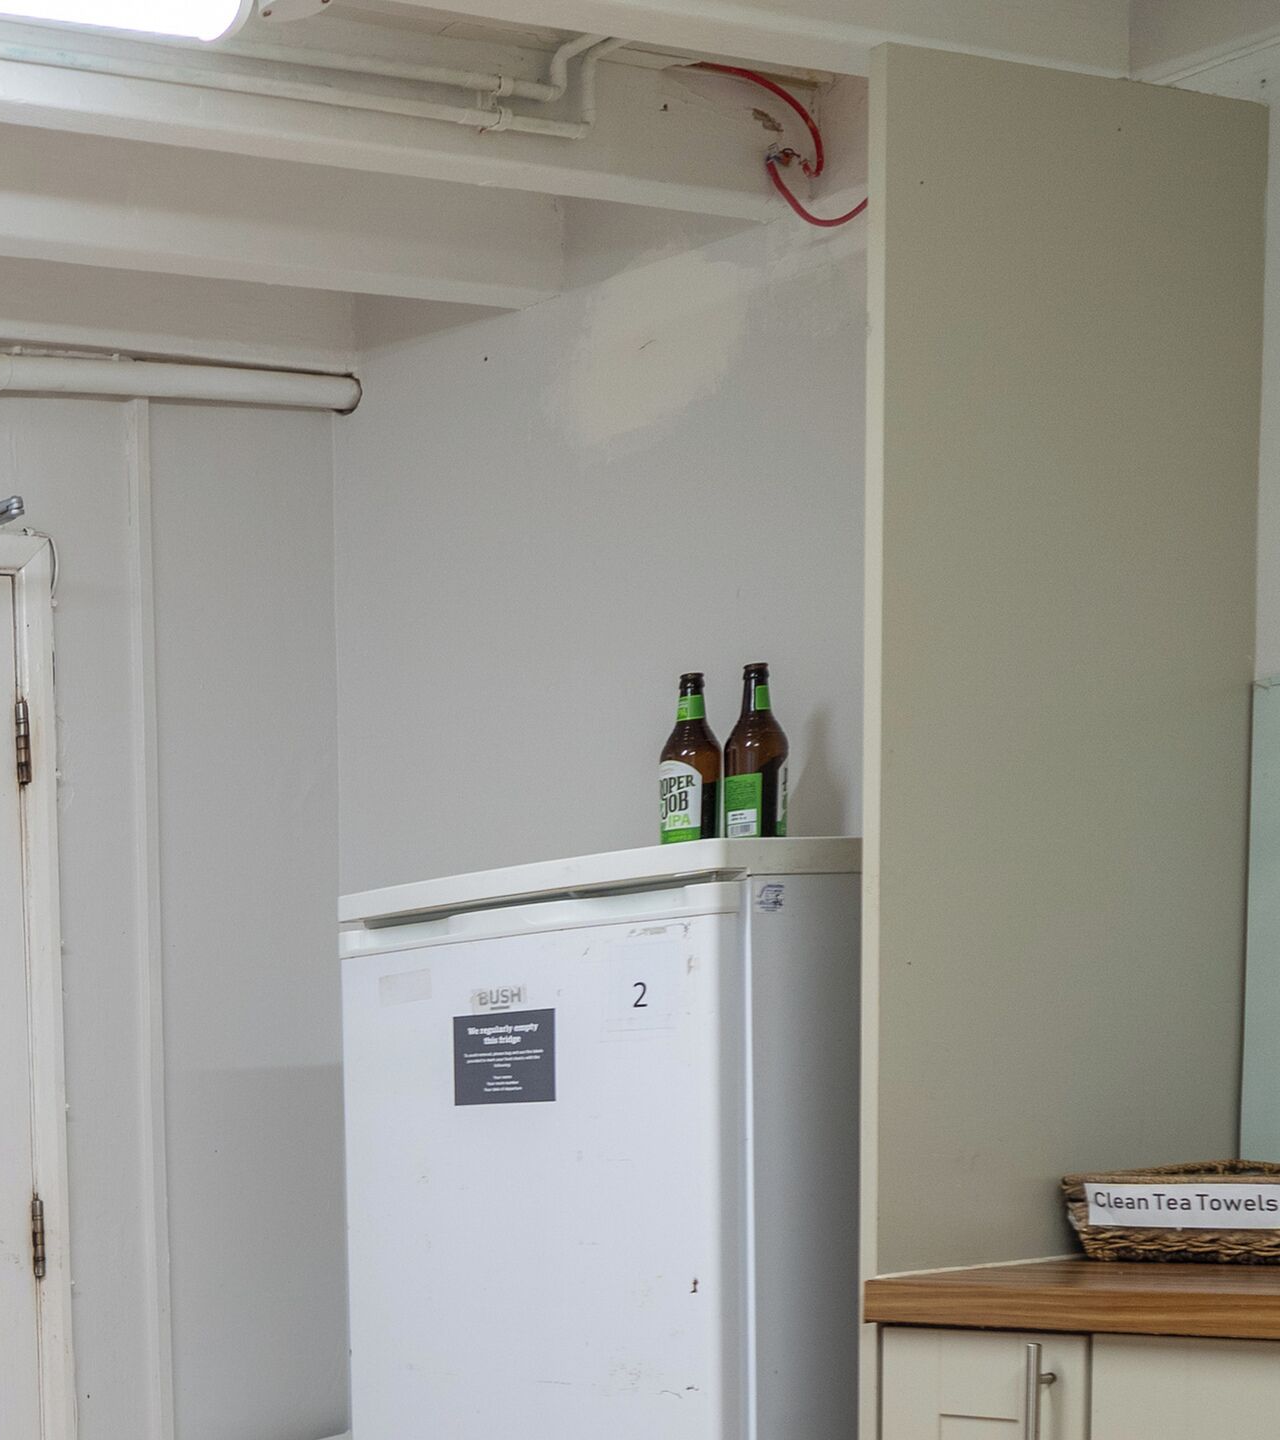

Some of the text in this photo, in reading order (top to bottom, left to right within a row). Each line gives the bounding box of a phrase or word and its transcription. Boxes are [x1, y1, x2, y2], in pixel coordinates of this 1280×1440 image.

[659, 774, 696, 798] OPER
[662, 791, 689, 820] JOB
[669, 814, 692, 828] IPA
[478, 987, 522, 1006] BUSH
[632, 982, 648, 1008] 2
[467, 1027, 478, 1035] We
[483, 1035, 521, 1044] this fridge
[1094, 1192, 1279, 1212] Clean Tea Towels
